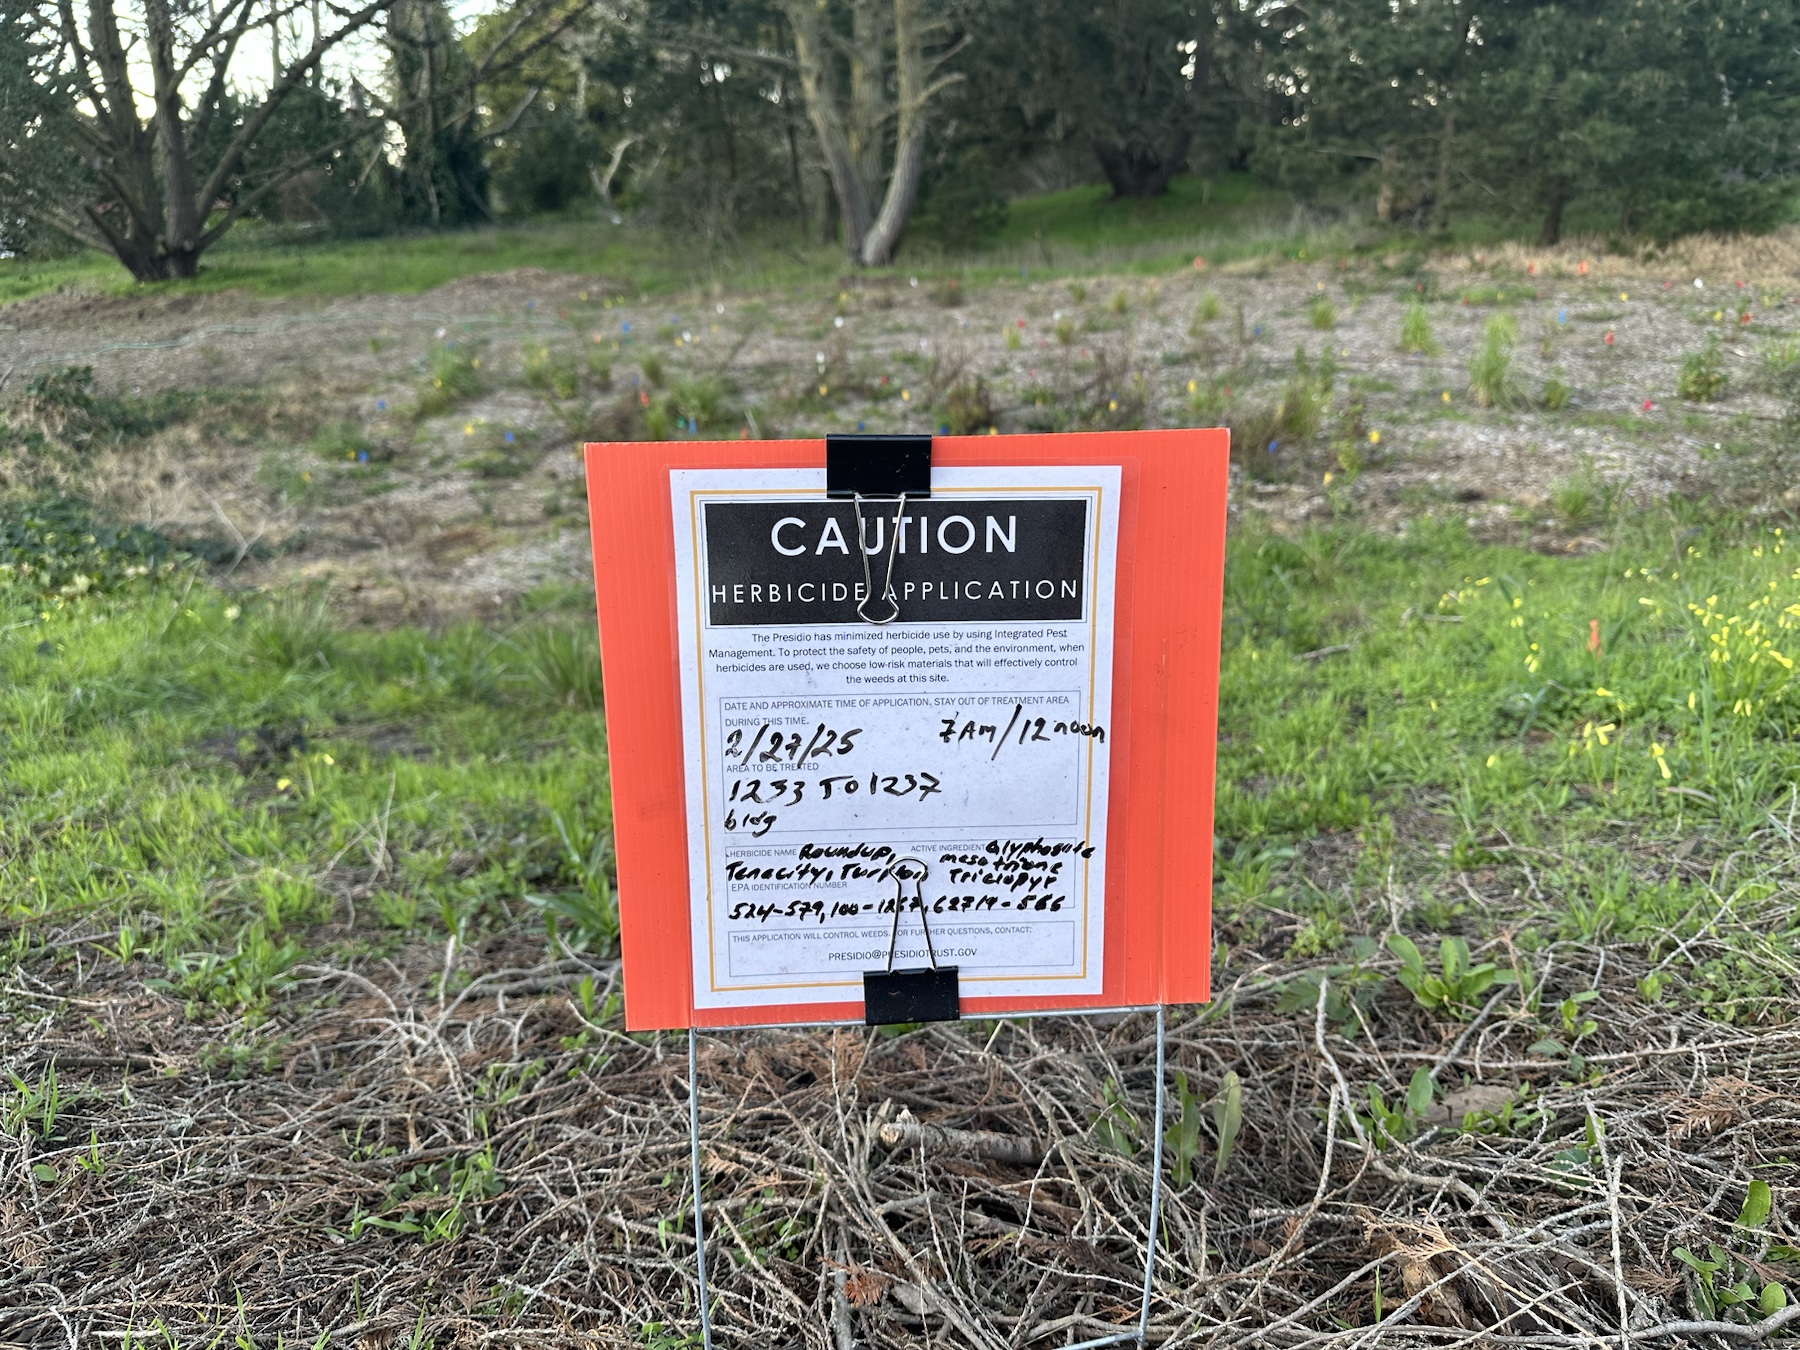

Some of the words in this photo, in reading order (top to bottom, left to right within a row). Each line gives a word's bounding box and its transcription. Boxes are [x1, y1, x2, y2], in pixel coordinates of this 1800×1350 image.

[770, 515, 1017, 556] CAUTION
[711, 582, 865, 604] HERBICIDE
[881, 579, 1078, 601] APPLICATION
[752, 633, 770, 642] The
[772, 632, 812, 642] Presidio
[814, 632, 832, 641] has
[834, 631, 883, 641] minimized
[886, 630, 930, 640] herbicide
[933, 631, 950, 639] use
[953, 630, 964, 641] by
[966, 630, 993, 641] using
[994, 629, 1043, 640] Integrated
[1046, 629, 1068, 638] Pest
[708, 649, 776, 660] Management.
[779, 648, 790, 657] To
[793, 647, 827, 658] protect
[829, 647, 845, 656] the
[846, 646, 876, 657] safety
[878, 646, 889, 655] of
[891, 645, 926, 655] people,
[928, 645, 952, 655] pets,
[954, 644, 973, 653] and
[975, 644, 991, 653] the
[993, 644, 1057, 654] environment,
[1059, 643, 1085, 652] when
[716, 663, 767, 673] herbicides
[787, 662, 814, 672] used,
[832, 661, 867, 670] choose
[869, 660, 905, 669] low-risk
[907, 659, 952, 668] materials
[954, 659, 974, 668] that
[976, 658, 991, 667] will
[994, 658, 1042, 669] effectively
[1044, 658, 1078, 667] control
[846, 675, 862, 684] the
[864, 674, 895, 684] weeds
[897, 674, 907, 683] at
[909, 674, 927, 682] this
[929, 673, 949, 682] site.
[724, 702, 748, 711] DATE
[750, 702, 769, 710] AND
[771, 700, 833, 710] APPROXIMATE
[835, 699, 856, 708] TIME
[859, 699, 871, 708] OF
[873, 698, 932, 708] APPLICATION.
[934, 697, 956, 706] STAY
[958, 697, 976, 706] OUT
[977, 697, 990, 705] OF
[992, 696, 1044, 705] TREATMENT
[1046, 695, 1070, 704] AREA
[725, 718, 760, 727] DURING
[762, 717, 783, 726] THIS
[785, 716, 810, 725] TIME.
[1053, 719, 1105, 744] noon
[725, 723, 863, 769] 2/27/25
[726, 763, 750, 773] AREA
[751, 763, 764, 772] TO
[766, 763, 777, 772] BE
[779, 763, 819, 771] TREATED
[729, 779, 805, 806] 1233
[870, 771, 942, 801] 1237
[730, 849, 772, 858] HERBICIDE
[774, 848, 797, 857] NAME
[911, 844, 937, 852] ACTIVE
[939, 843, 985, 852] INGREDIENT
[731, 883, 750, 892] EPA
[751, 882, 811, 891] IDENTIFICATION
[813, 881, 848, 890] NUMBER
[733, 934, 751, 943] THIS
[752, 933, 801, 942] APPLICATION
[803, 932, 822, 940] WILL
[823, 931, 859, 940] CONTROL
[861, 930, 891, 939] WEEDS.
[910, 928, 946, 936] FURHER
[947, 927, 993, 936] QUESTIONS,
[994, 926, 1032, 935] CONTACT:
